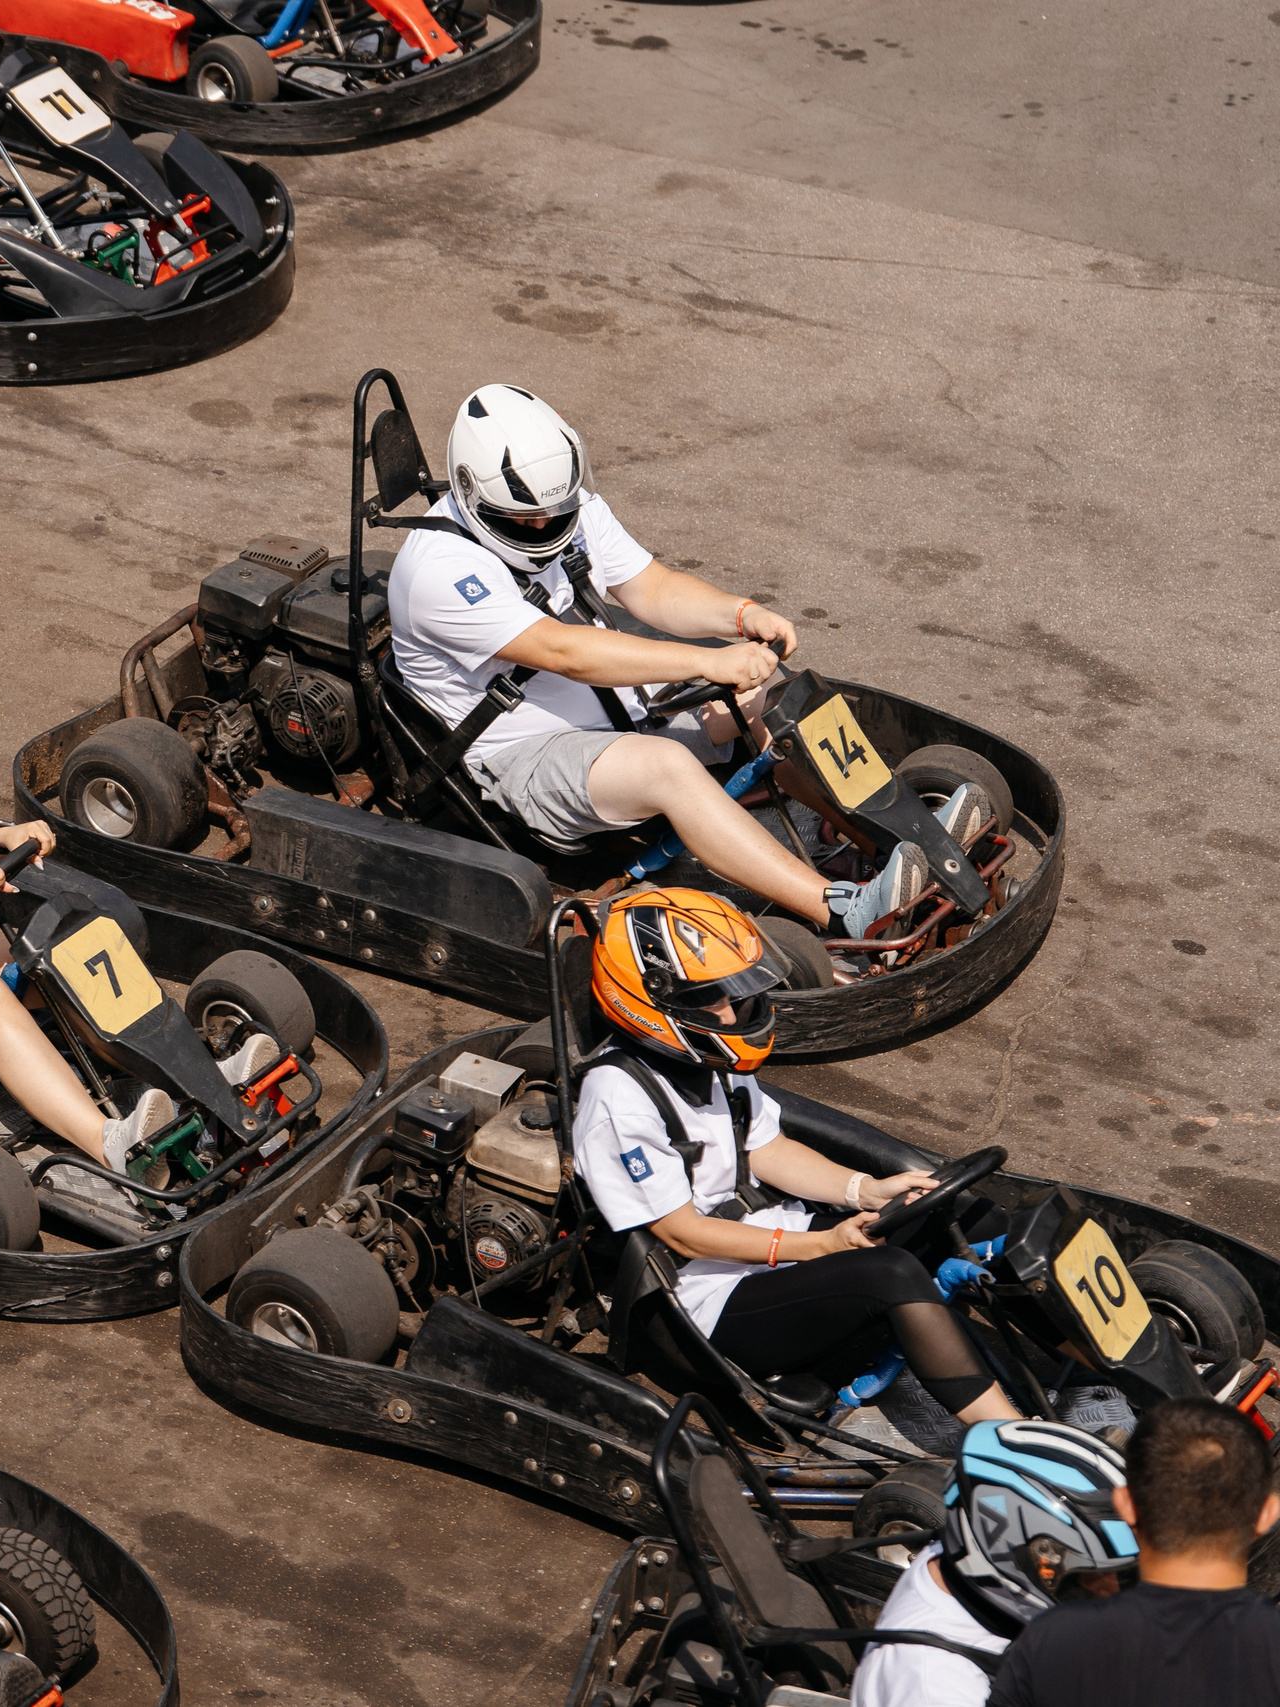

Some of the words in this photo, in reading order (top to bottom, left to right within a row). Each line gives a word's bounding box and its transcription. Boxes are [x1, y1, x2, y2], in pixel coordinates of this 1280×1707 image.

[39, 88, 86, 121] 11
[540, 482, 568, 499] HIZER
[818, 725, 869, 779] 14
[83, 949, 123, 999] 7
[1075, 1254, 1126, 1326] 10
